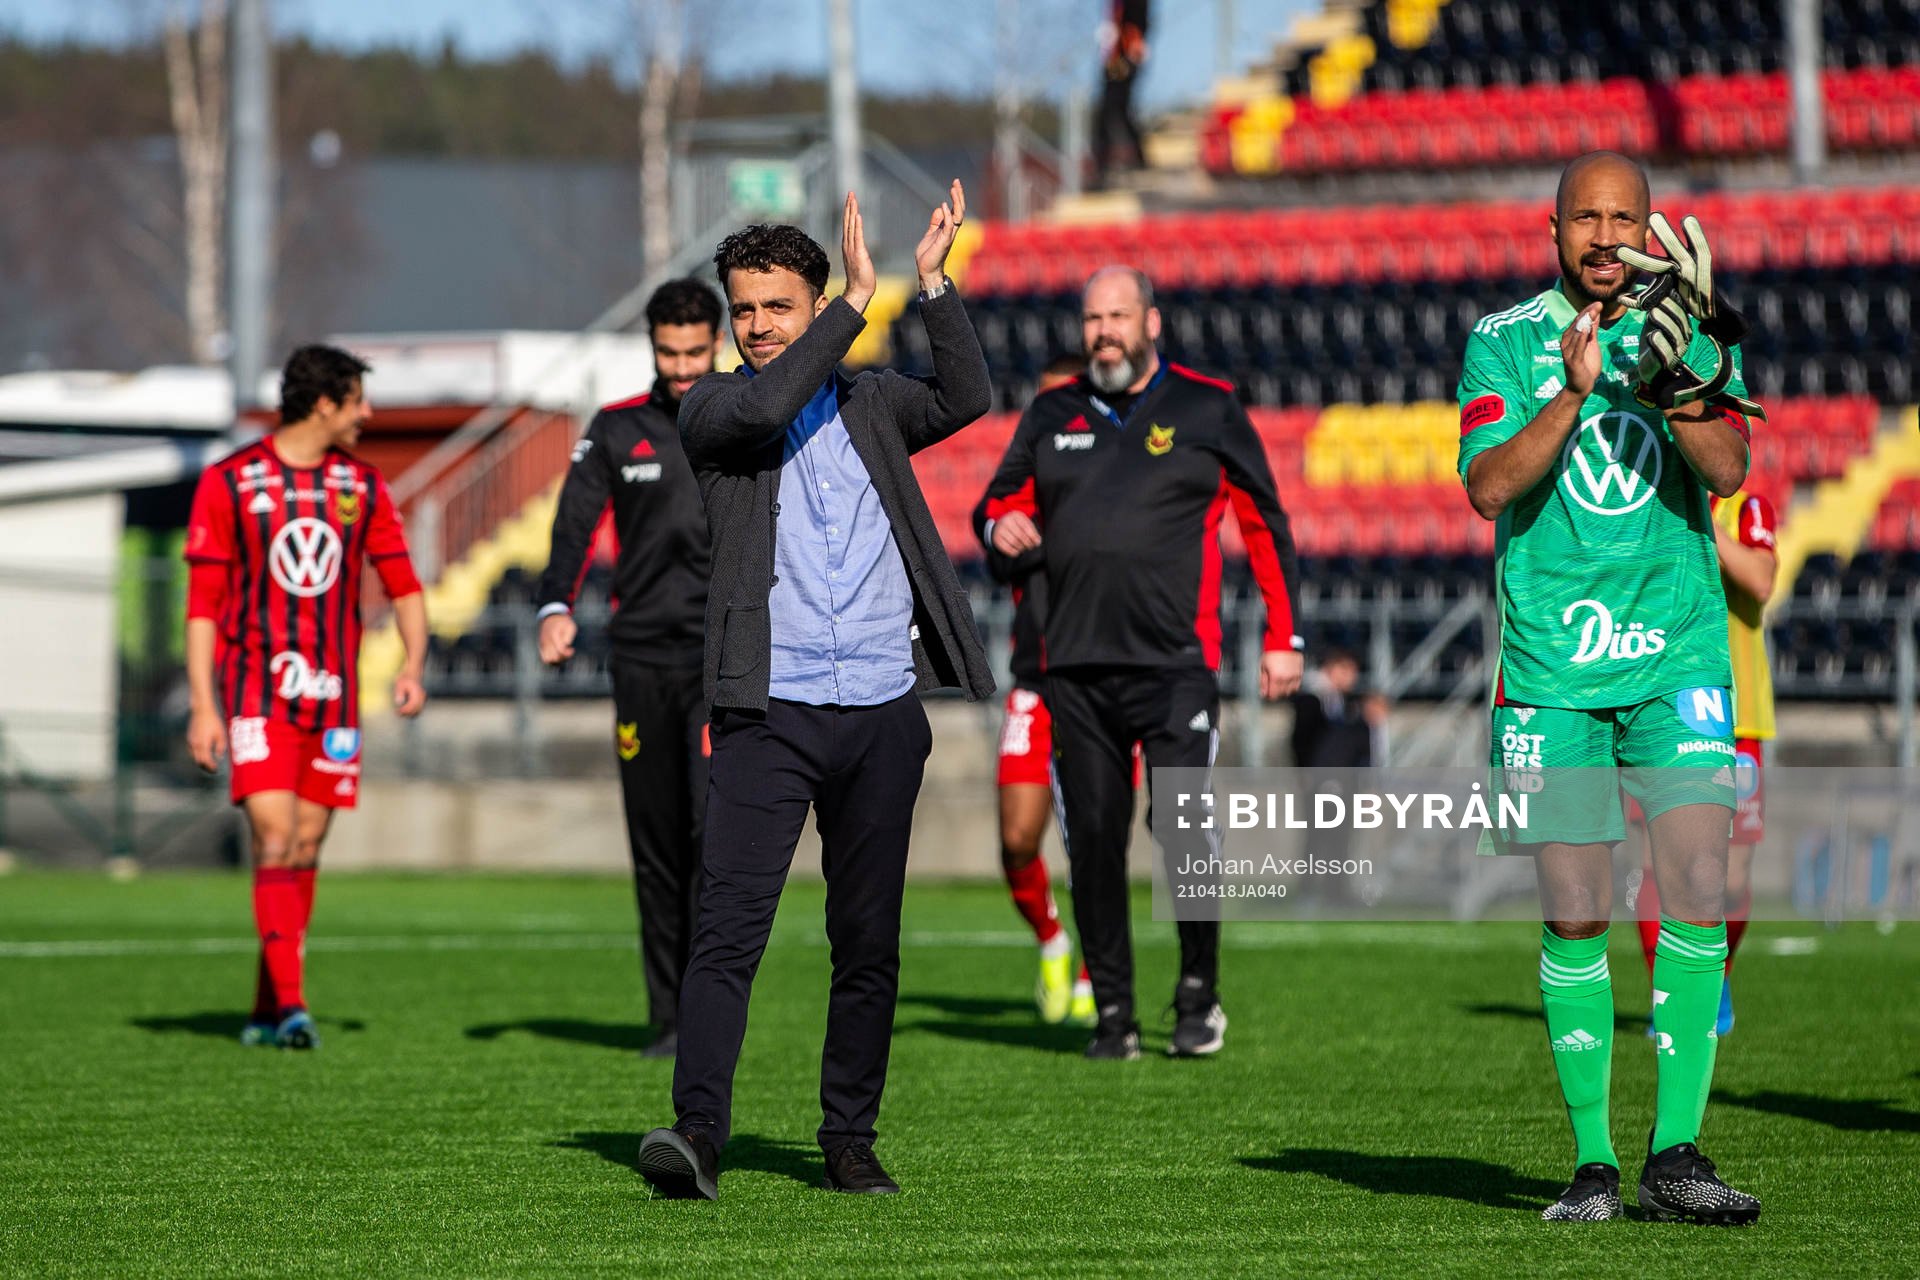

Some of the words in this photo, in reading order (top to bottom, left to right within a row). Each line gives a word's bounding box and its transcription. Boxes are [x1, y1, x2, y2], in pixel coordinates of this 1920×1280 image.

[275, 519, 337, 591] VW
[1563, 599, 1666, 663] Diös
[1692, 688, 1726, 722] N
[1502, 725, 1545, 754] ÖST
[1503, 752, 1543, 773] ERS
